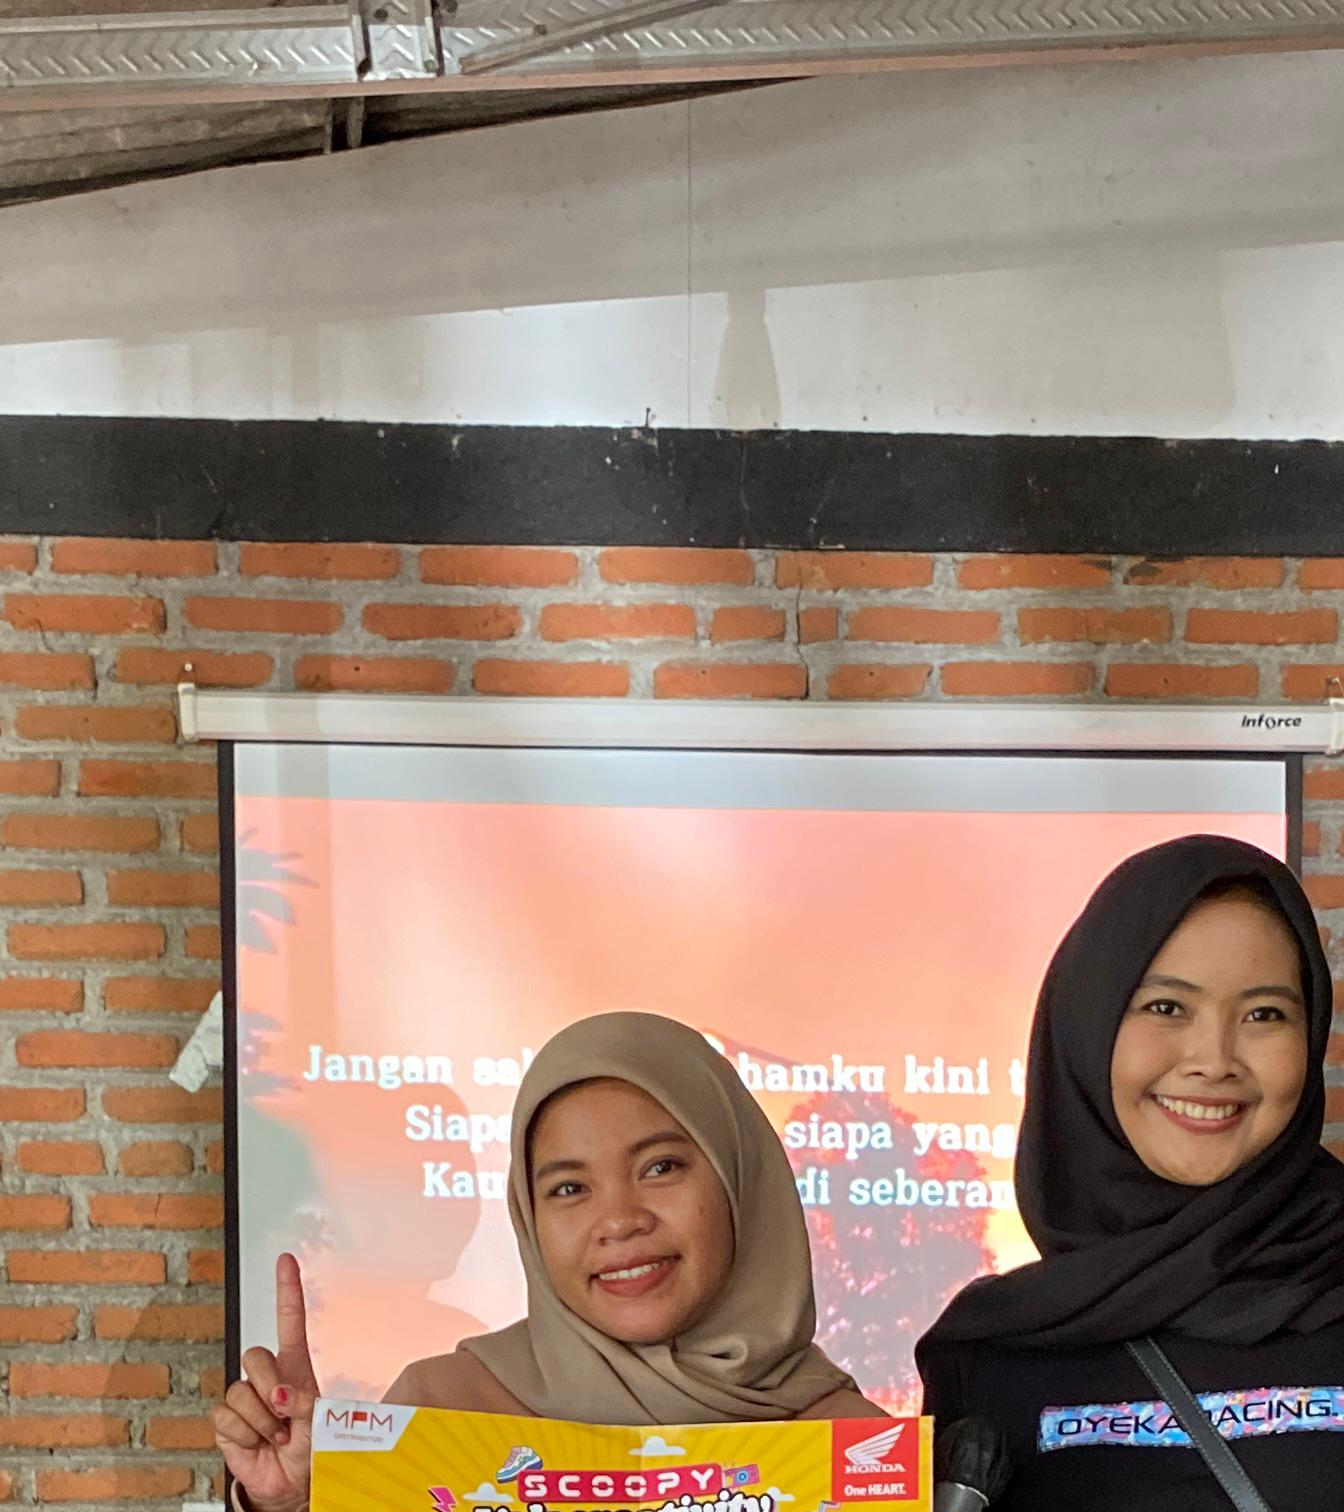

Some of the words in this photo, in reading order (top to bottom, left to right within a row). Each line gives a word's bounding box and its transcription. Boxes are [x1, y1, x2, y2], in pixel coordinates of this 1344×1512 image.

[303, 1045, 454, 1090] Jangan
[904, 1054, 990, 1095] kini
[784, 1113, 894, 1160] siapa
[911, 1121, 1016, 1160] yang
[848, 1168, 1015, 1209] seberan
[523, 1467, 715, 1498] SCOOPY
[844, 1463, 907, 1474] HONDA
[844, 1484, 867, 1497] One
